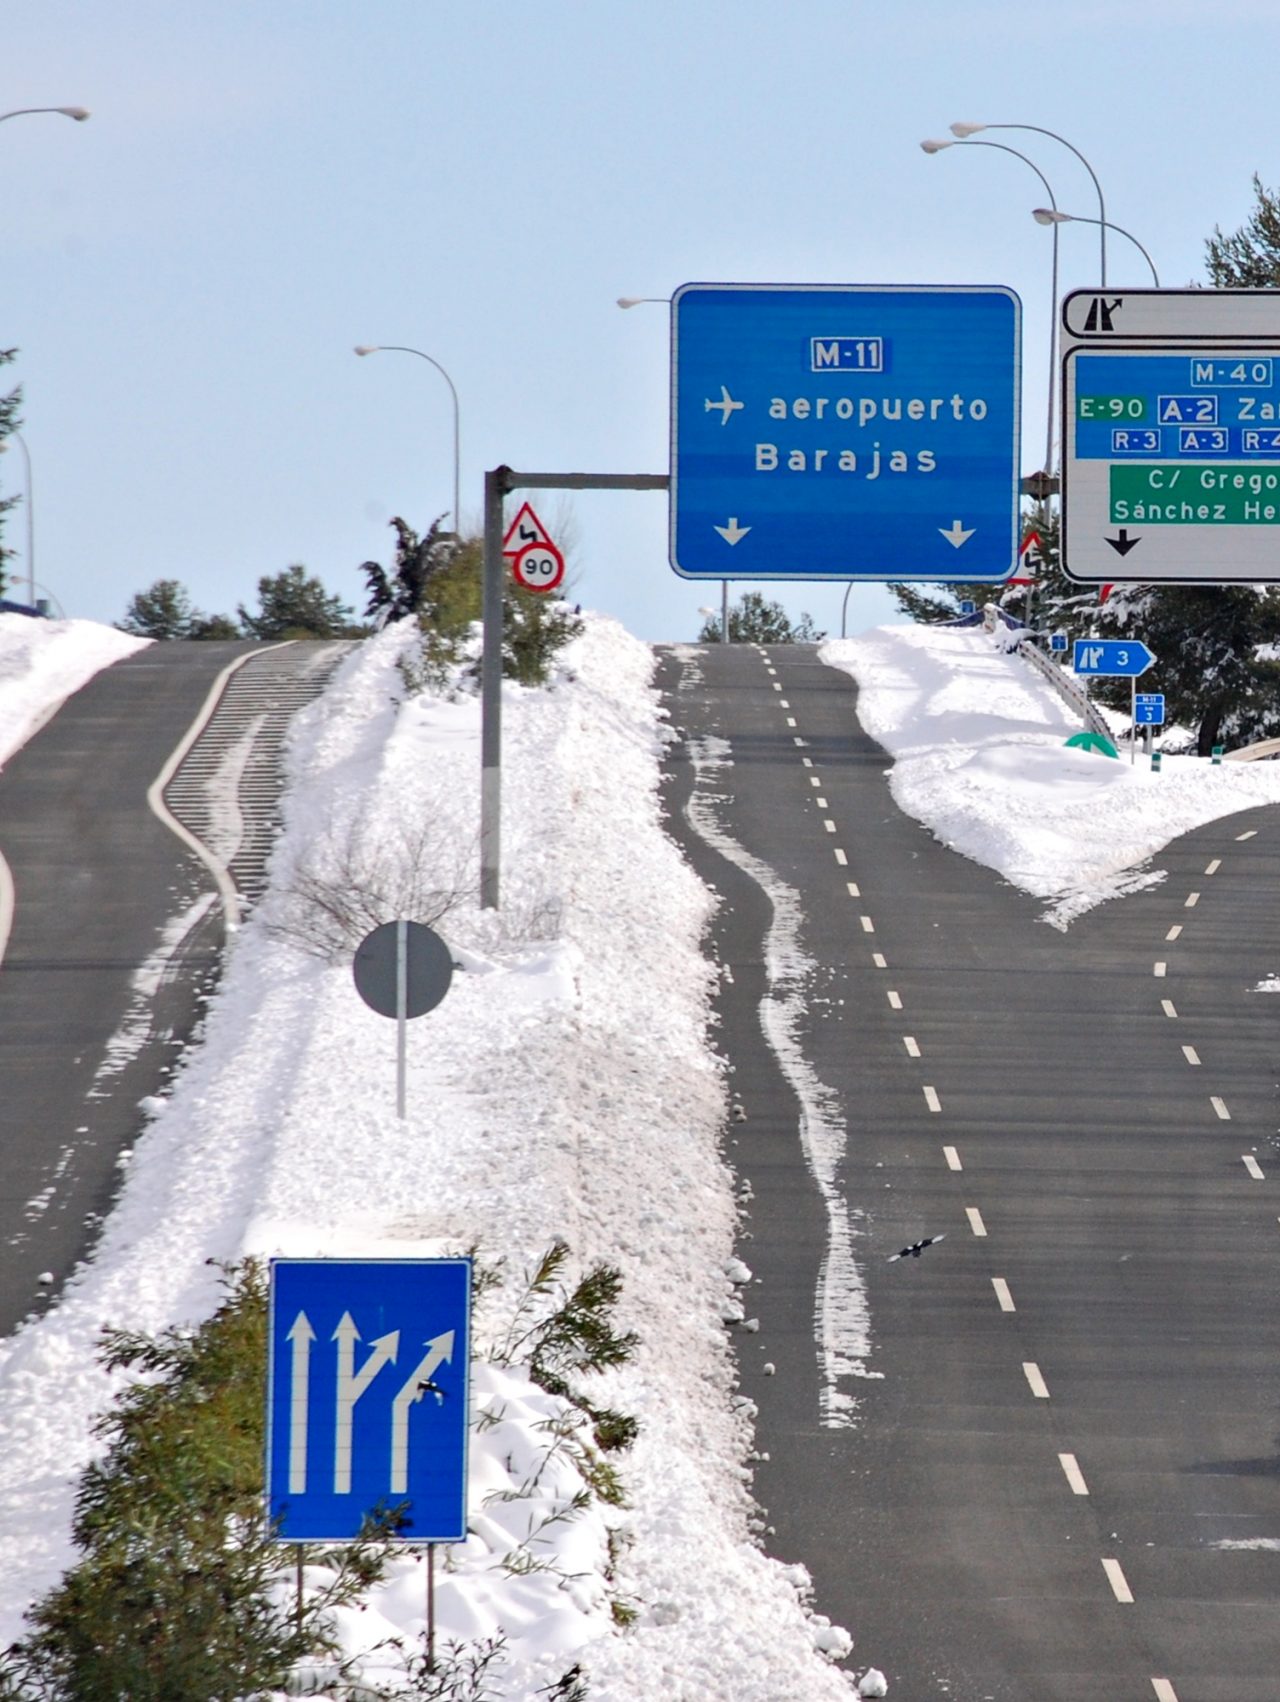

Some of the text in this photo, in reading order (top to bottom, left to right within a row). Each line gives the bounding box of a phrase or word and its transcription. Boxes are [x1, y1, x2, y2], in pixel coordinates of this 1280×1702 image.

[815, 341, 879, 368] M-11
[1195, 363, 1268, 383] M-40
[768, 393, 988, 427] aeropuerto
[1079, 398, 1144, 418] E-90
[1162, 400, 1214, 421] A-2
[1114, 433, 1158, 450] R-3
[1183, 433, 1226, 450] A-3
[755, 441, 937, 480] Barajas
[1148, 470, 1181, 491] C/
[1114, 499, 1227, 521] Sánchez
[525, 558, 553, 575] 90
[1116, 650, 1129, 666] 3
[1145, 711, 1153, 721] 3
